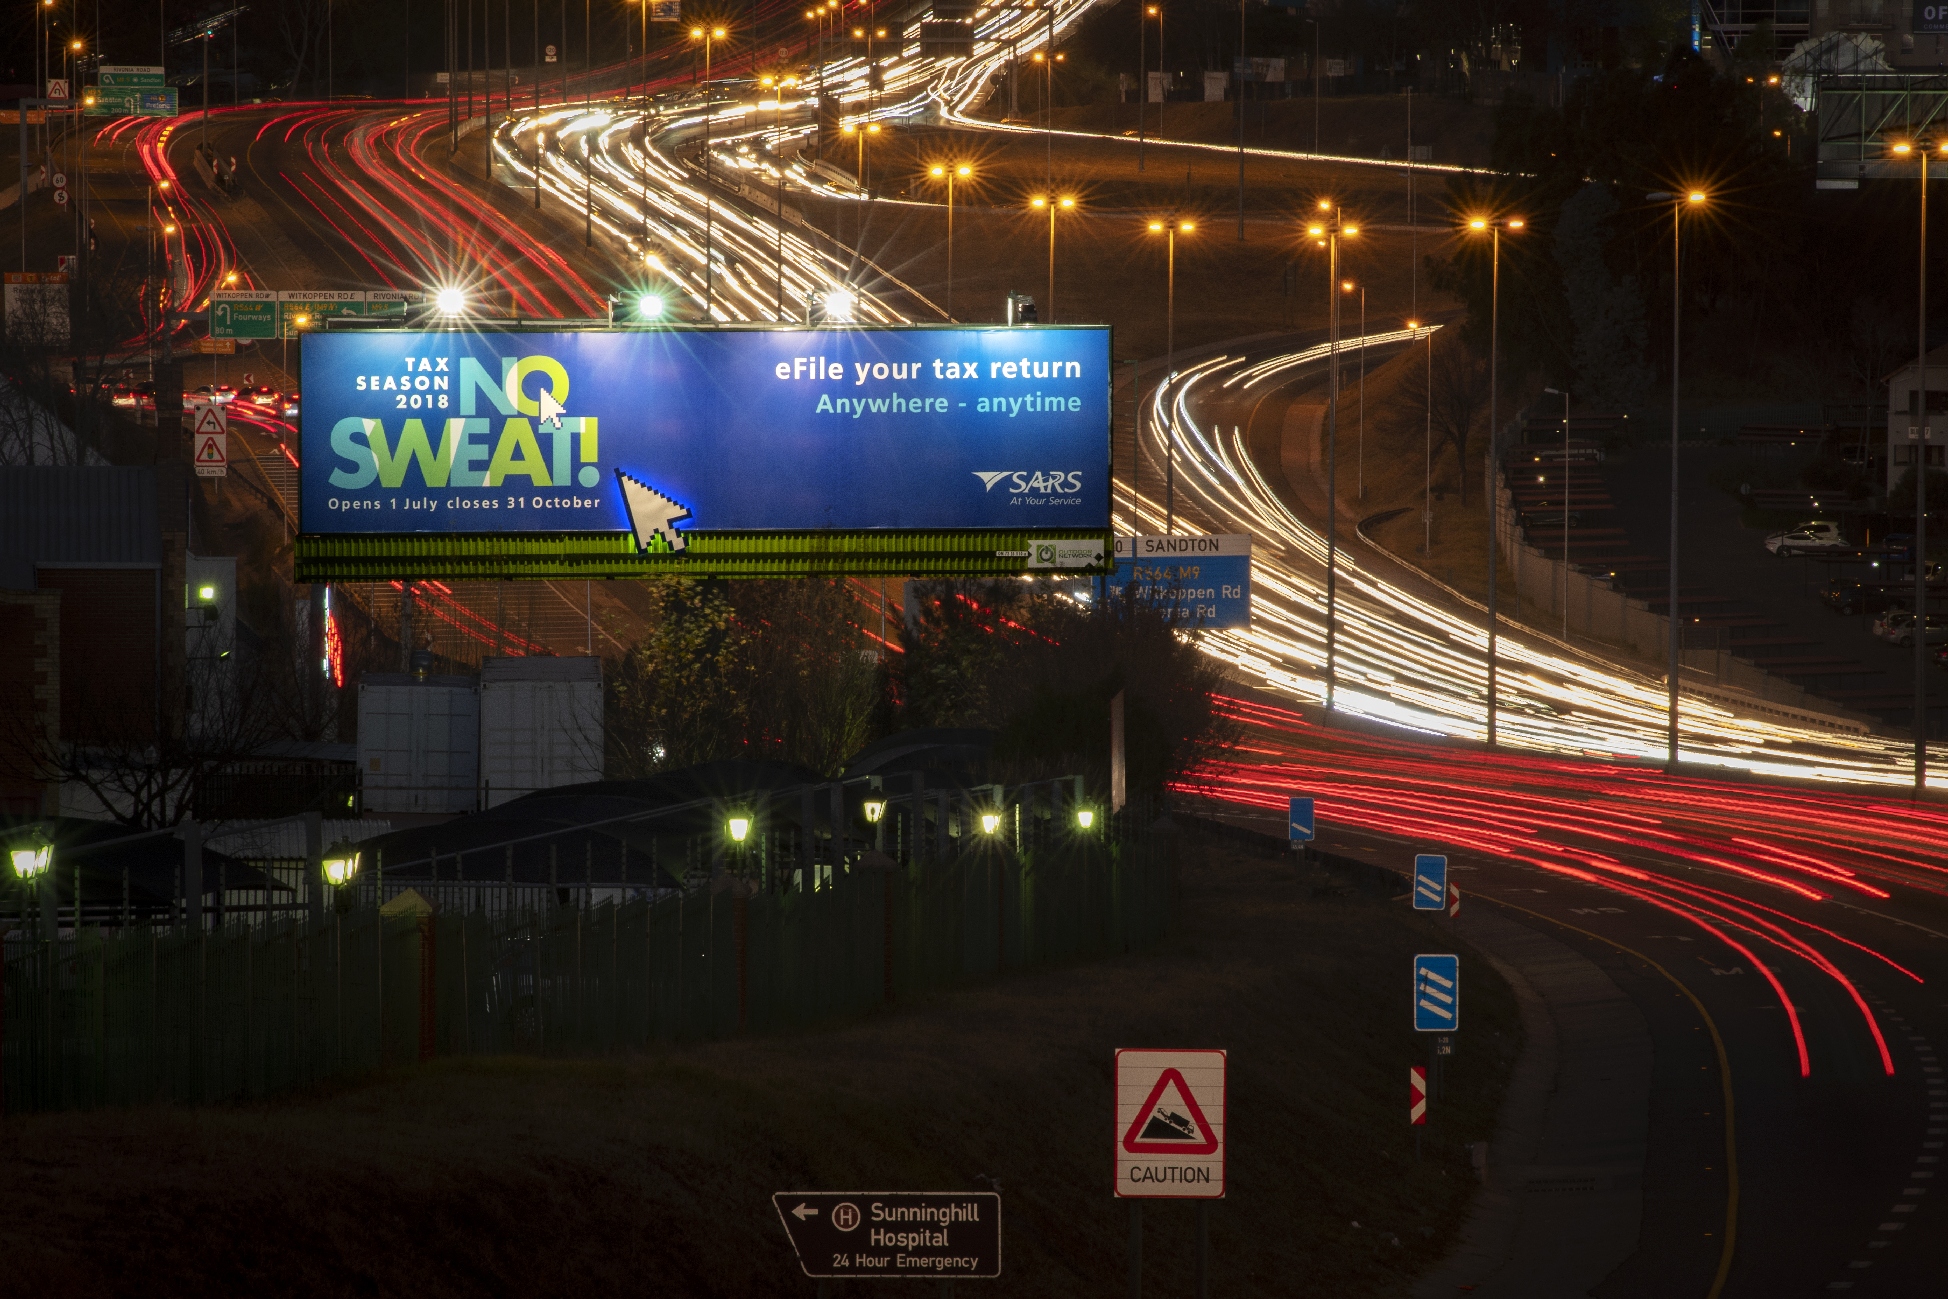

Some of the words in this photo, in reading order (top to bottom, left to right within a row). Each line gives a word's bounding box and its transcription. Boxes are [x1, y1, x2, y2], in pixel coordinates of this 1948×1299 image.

[234, 313, 271, 322] Fourways
[406, 357, 449, 372] TAX
[775, 356, 844, 380] eFile
[854, 362, 922, 385] your
[932, 359, 979, 380] tax
[990, 357, 1081, 379] return
[356, 375, 449, 390] SEASON
[460, 355, 570, 416] NO
[396, 394, 449, 409] 2018
[816, 393, 948, 418] Anywhere
[976, 392, 1082, 417] anytime
[328, 416, 600, 490] SWEAT!
[1009, 470, 1082, 493] SARS
[328, 498, 381, 511] Opens
[390, 499, 397, 509] 1
[404, 497, 438, 511] July
[447, 497, 499, 509] closes
[507, 498, 525, 509] 31
[532, 497, 600, 509] October
[1010, 496, 1022, 505] At
[1026, 496, 1046, 505] Your
[1049, 496, 1081, 505] Service
[1146, 539, 1219, 552] SANDTON
[1134, 566, 1172, 580] R564
[1180, 566, 1200, 579] M9
[1222, 585, 1241, 599] Rd
[1197, 604, 1215, 618] Rd
[1130, 1166, 1210, 1183] CAUTION
[871, 1203, 979, 1226] Sunninghill
[871, 1228, 948, 1251] Hospital
[833, 1254, 849, 1267] 24
[856, 1254, 890, 1268] Hour
[897, 1253, 978, 1270] Emergency
